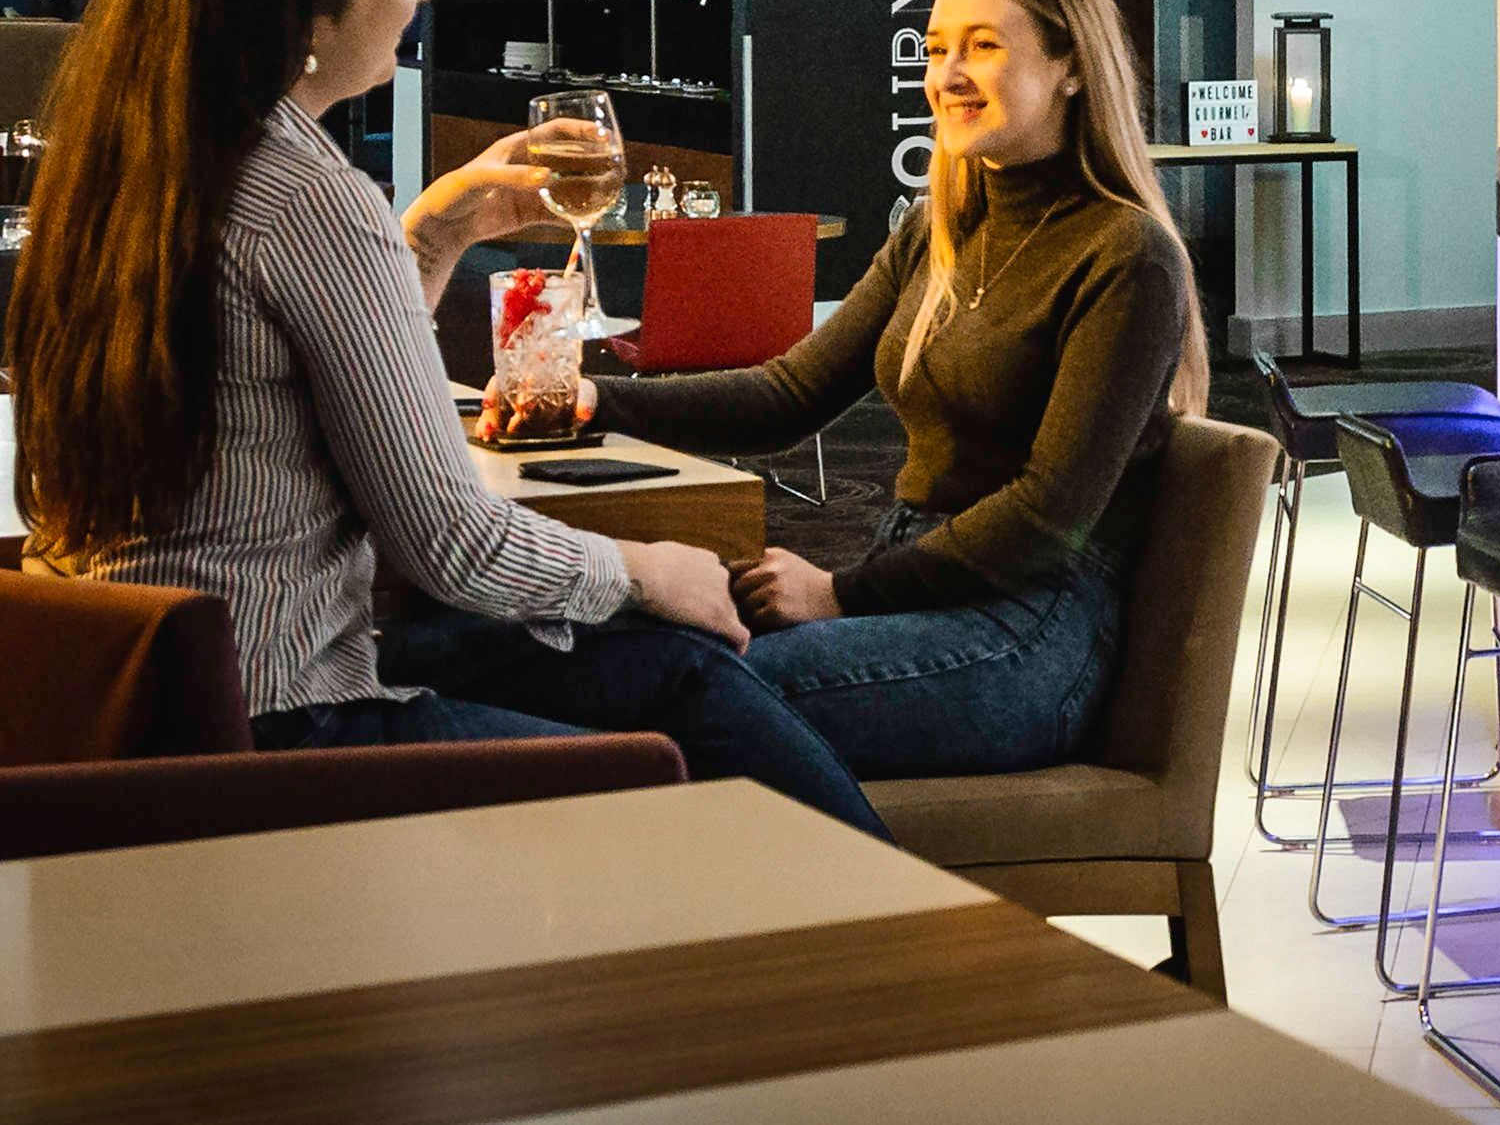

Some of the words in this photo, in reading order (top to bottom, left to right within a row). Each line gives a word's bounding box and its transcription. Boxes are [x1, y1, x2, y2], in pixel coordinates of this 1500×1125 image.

[1199, 85, 1253, 99] WELCOME
[1196, 105, 1245, 120] GOURMET
[1211, 127, 1232, 140] BAR
